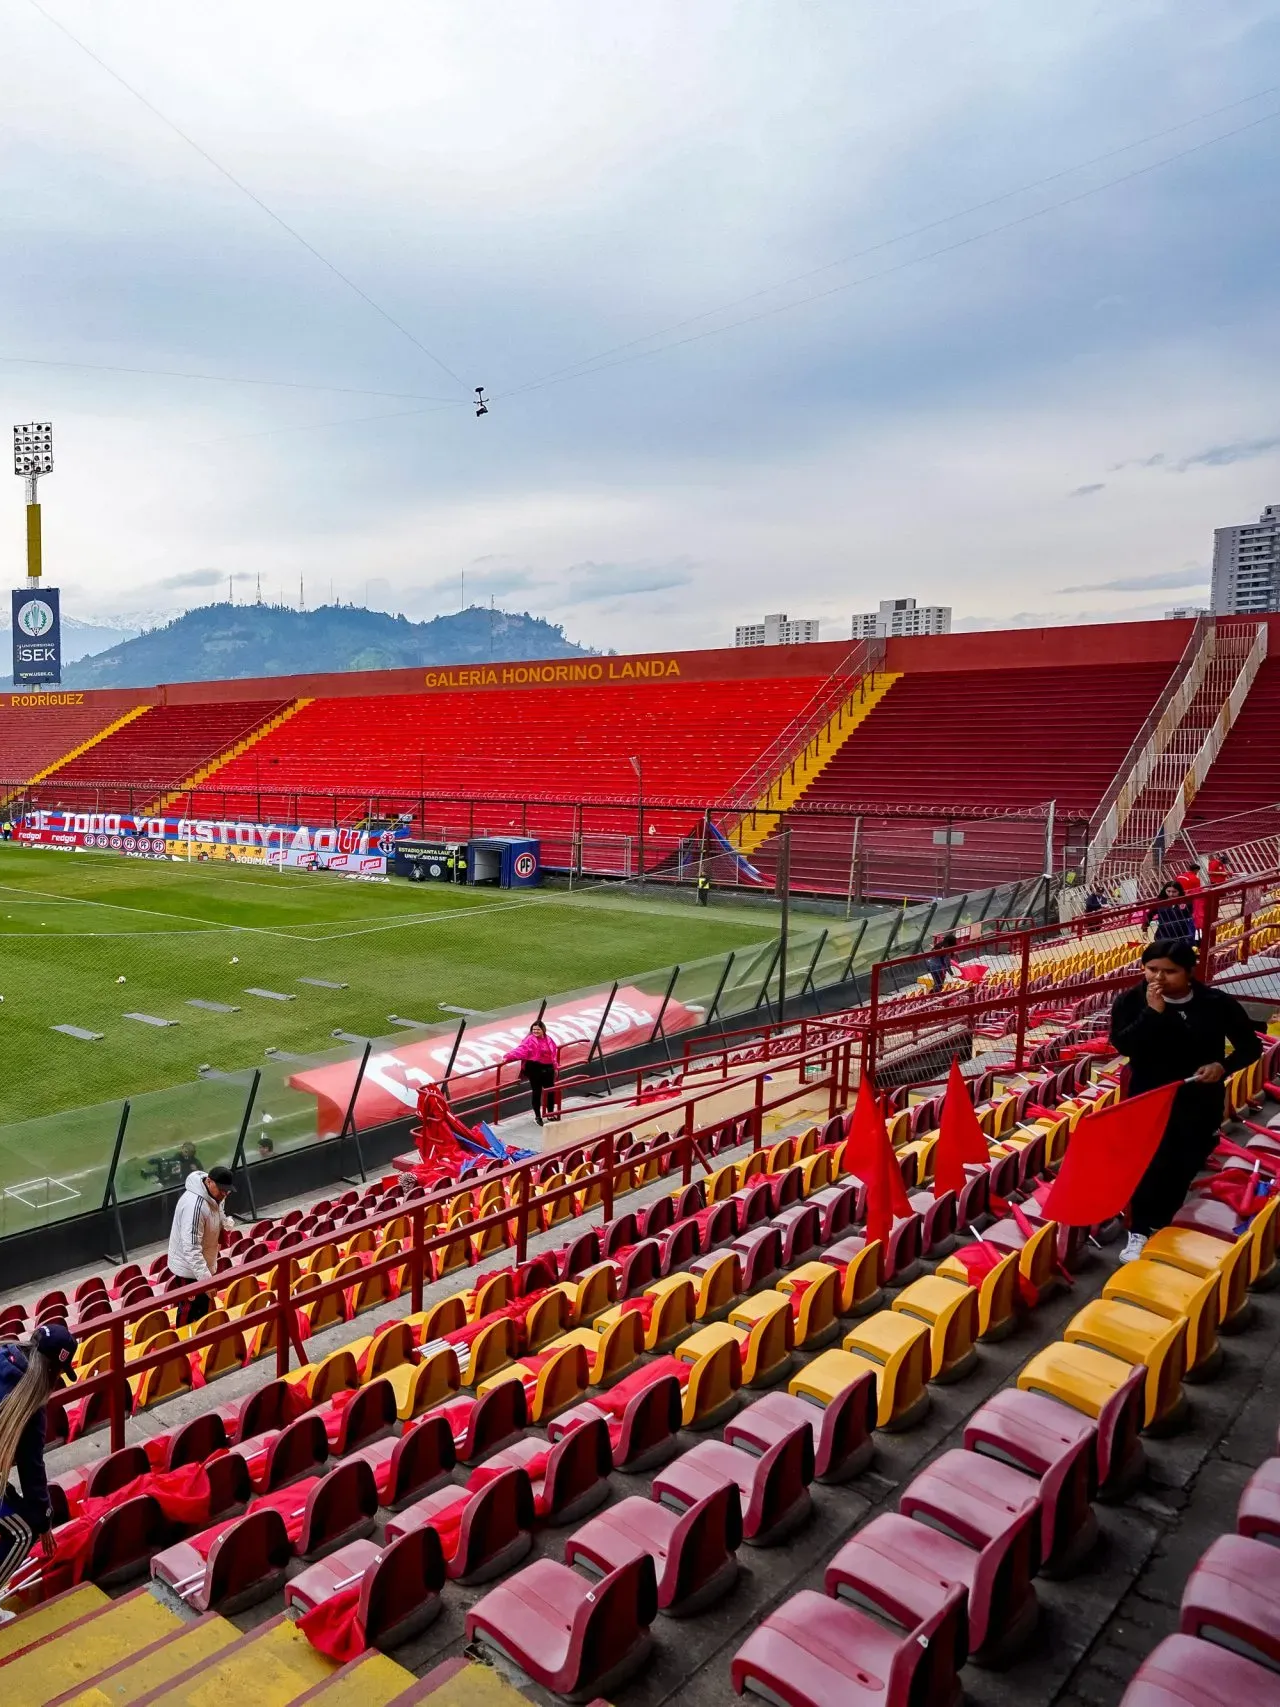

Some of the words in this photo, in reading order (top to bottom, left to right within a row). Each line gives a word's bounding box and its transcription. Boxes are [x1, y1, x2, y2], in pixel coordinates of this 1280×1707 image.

[22, 648, 56, 662] SEK
[425, 666, 498, 688] GALERÍA
[502, 663, 603, 684] HONORINO
[608, 659, 681, 679] LANDA
[11, 692, 84, 707] RODRÍGUEZ
[19, 832, 41, 840] redgol
[52, 834, 76, 843] redgol
[133, 816, 166, 839] YO
[178, 818, 277, 847] ESTOY
[237, 856, 273, 866] SODIMAC
[520, 858, 531, 873] PF
